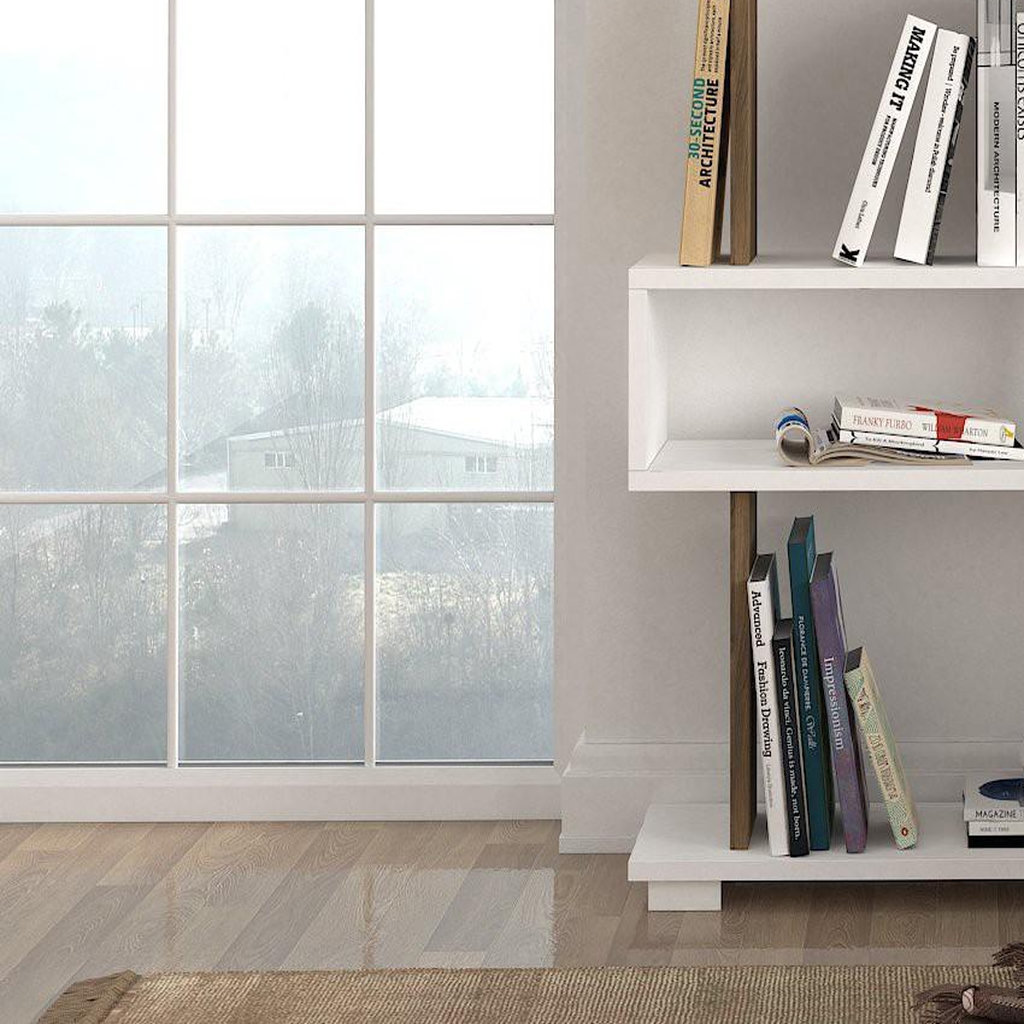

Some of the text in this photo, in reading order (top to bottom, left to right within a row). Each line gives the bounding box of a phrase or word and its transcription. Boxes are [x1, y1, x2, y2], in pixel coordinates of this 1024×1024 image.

[890, 26, 926, 111] MAKING IT
[688, 78, 706, 159] 30-SECOND
[699, 78, 719, 188] ARCHITECTURE
[852, 414, 884, 428] FRANKY
[885, 418, 912, 430] FURBO
[752, 592, 766, 647] Advanced
[757, 662, 769, 706] Fashion
[778, 647, 790, 688] leonardo
[782, 690, 791, 701] da
[784, 704, 793, 726] vinci.
[822, 658, 844, 750] Impressionism
[762, 708, 772, 758] Drawing
[786, 728, 794, 758] Genius
[789, 760, 796, 768] is
[790, 769, 798, 798] made,
[975, 810, 1016, 819] MAGAZINE
